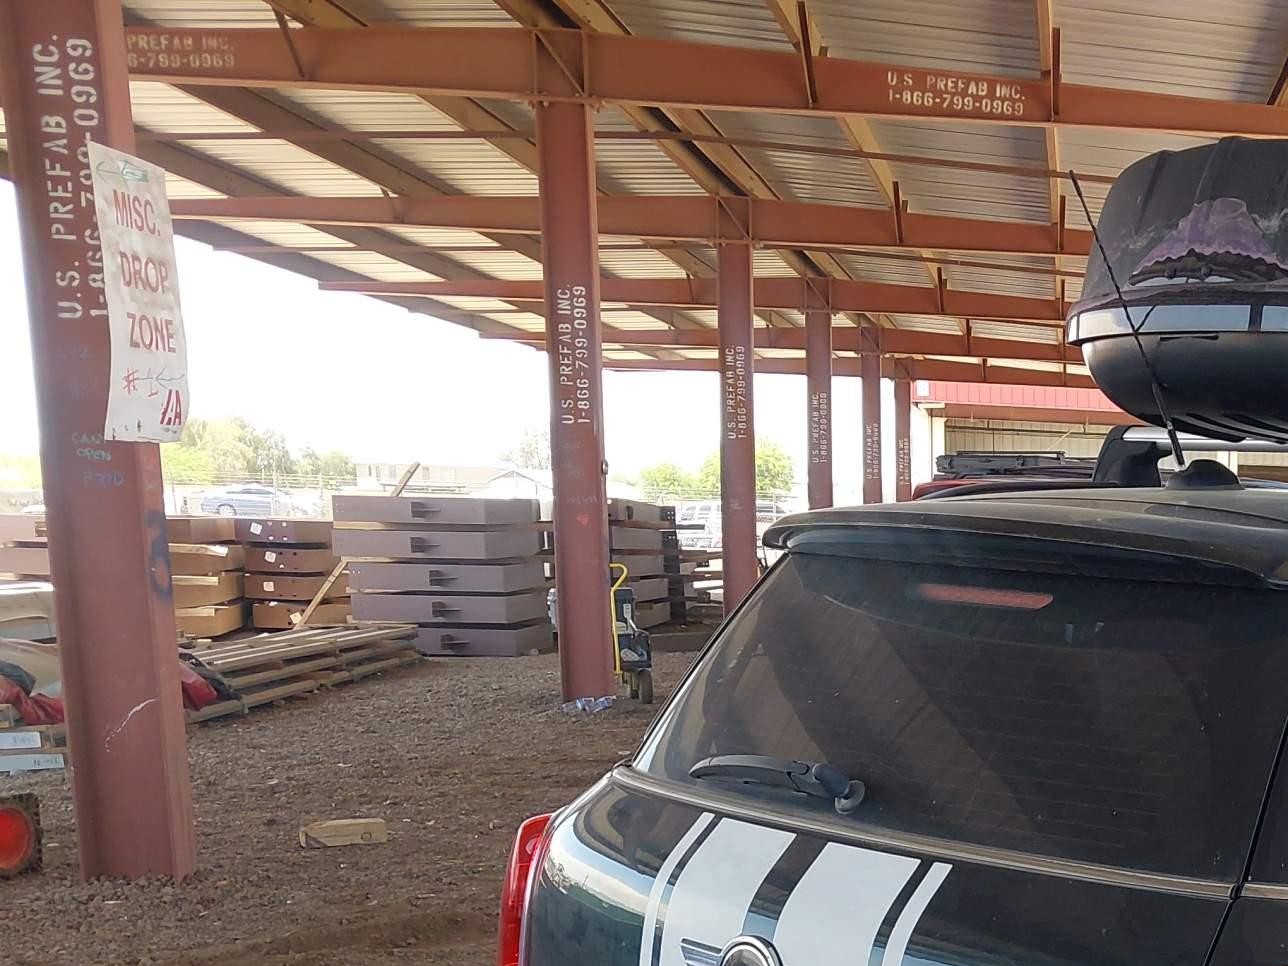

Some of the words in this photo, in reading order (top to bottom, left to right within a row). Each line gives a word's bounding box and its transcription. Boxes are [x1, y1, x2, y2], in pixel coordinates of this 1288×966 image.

[127, 34, 193, 50] PREFAB
[127, 53, 234, 68] 6-799-0969
[32, 34, 64, 96] INC.
[888, 88, 1024, 117] 1-866-799-0969
[927, 75, 988, 96] PREFAB
[996, 83, 1026, 100] INC.
[41, 115, 77, 240] PREFAB
[112, 189, 161, 236] MISC.
[55, 261, 83, 319] U.S.
[120, 251, 169, 294] DROP
[556, 284, 572, 315] INC.
[127, 312, 176, 353] ZONE
[558, 323, 574, 385] PREFAB
[572, 286, 591, 423] 1-866-799-0969
[725, 344, 735, 366] INC.
[725, 371, 737, 413] PREFAB
[735, 345, 748, 439] 1-866-799-0969
